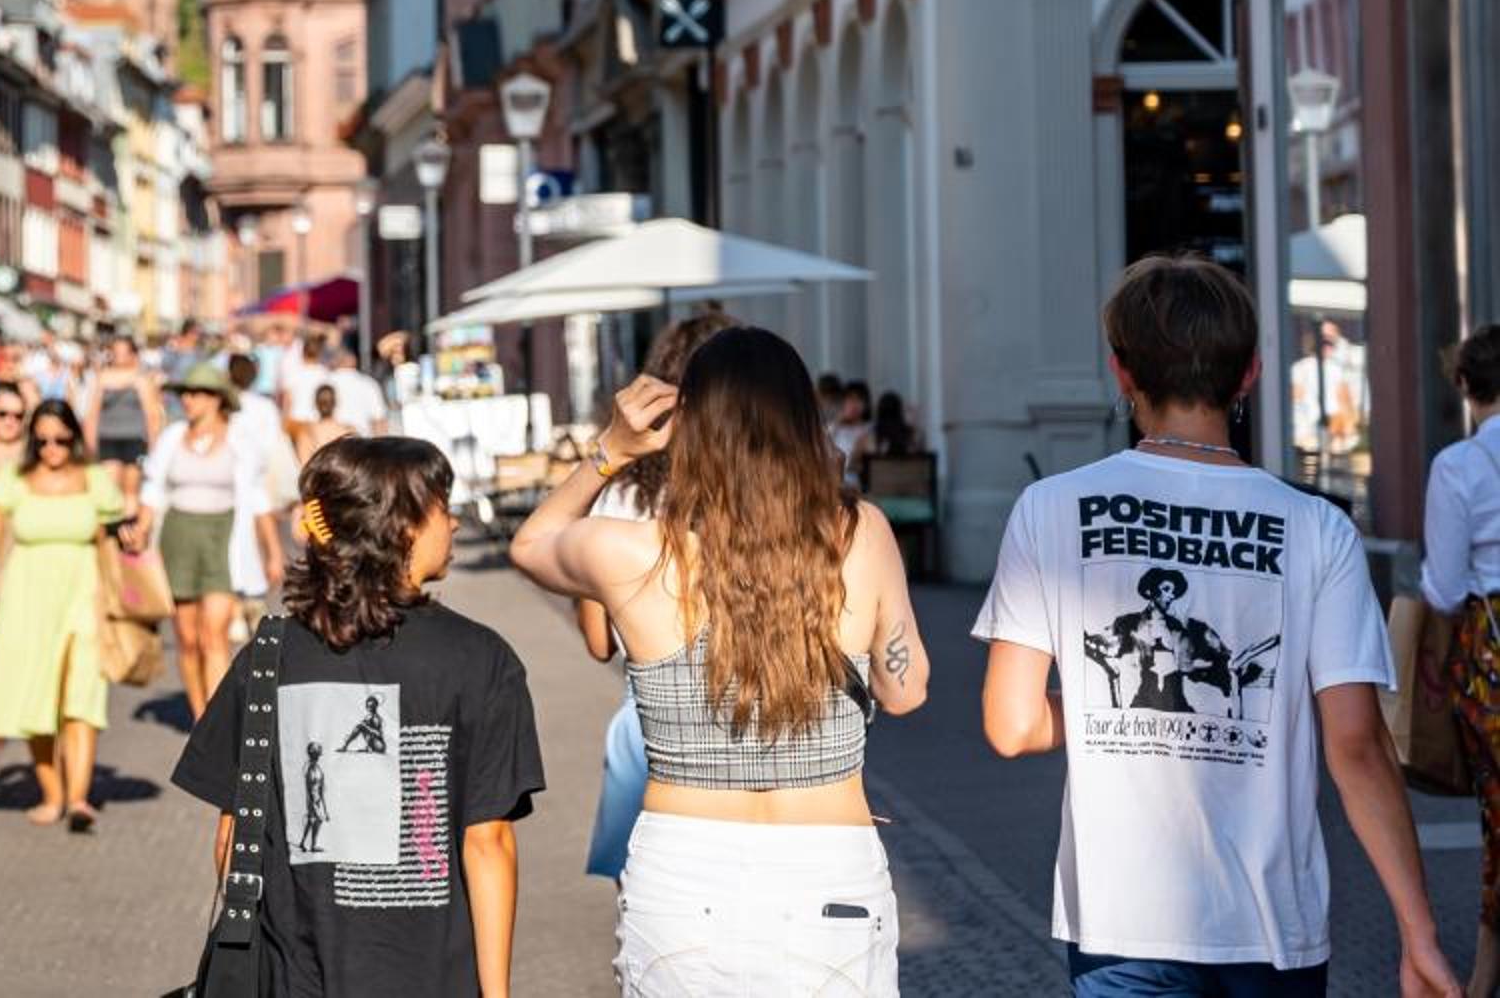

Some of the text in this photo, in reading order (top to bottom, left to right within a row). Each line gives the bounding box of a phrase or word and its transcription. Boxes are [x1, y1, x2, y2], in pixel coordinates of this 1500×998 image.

[1078, 494, 1285, 544] POSITIVE
[1081, 527, 1284, 575] FEEDBACK
[1083, 713, 1110, 738] Tour
[1113, 713, 1128, 738] de
